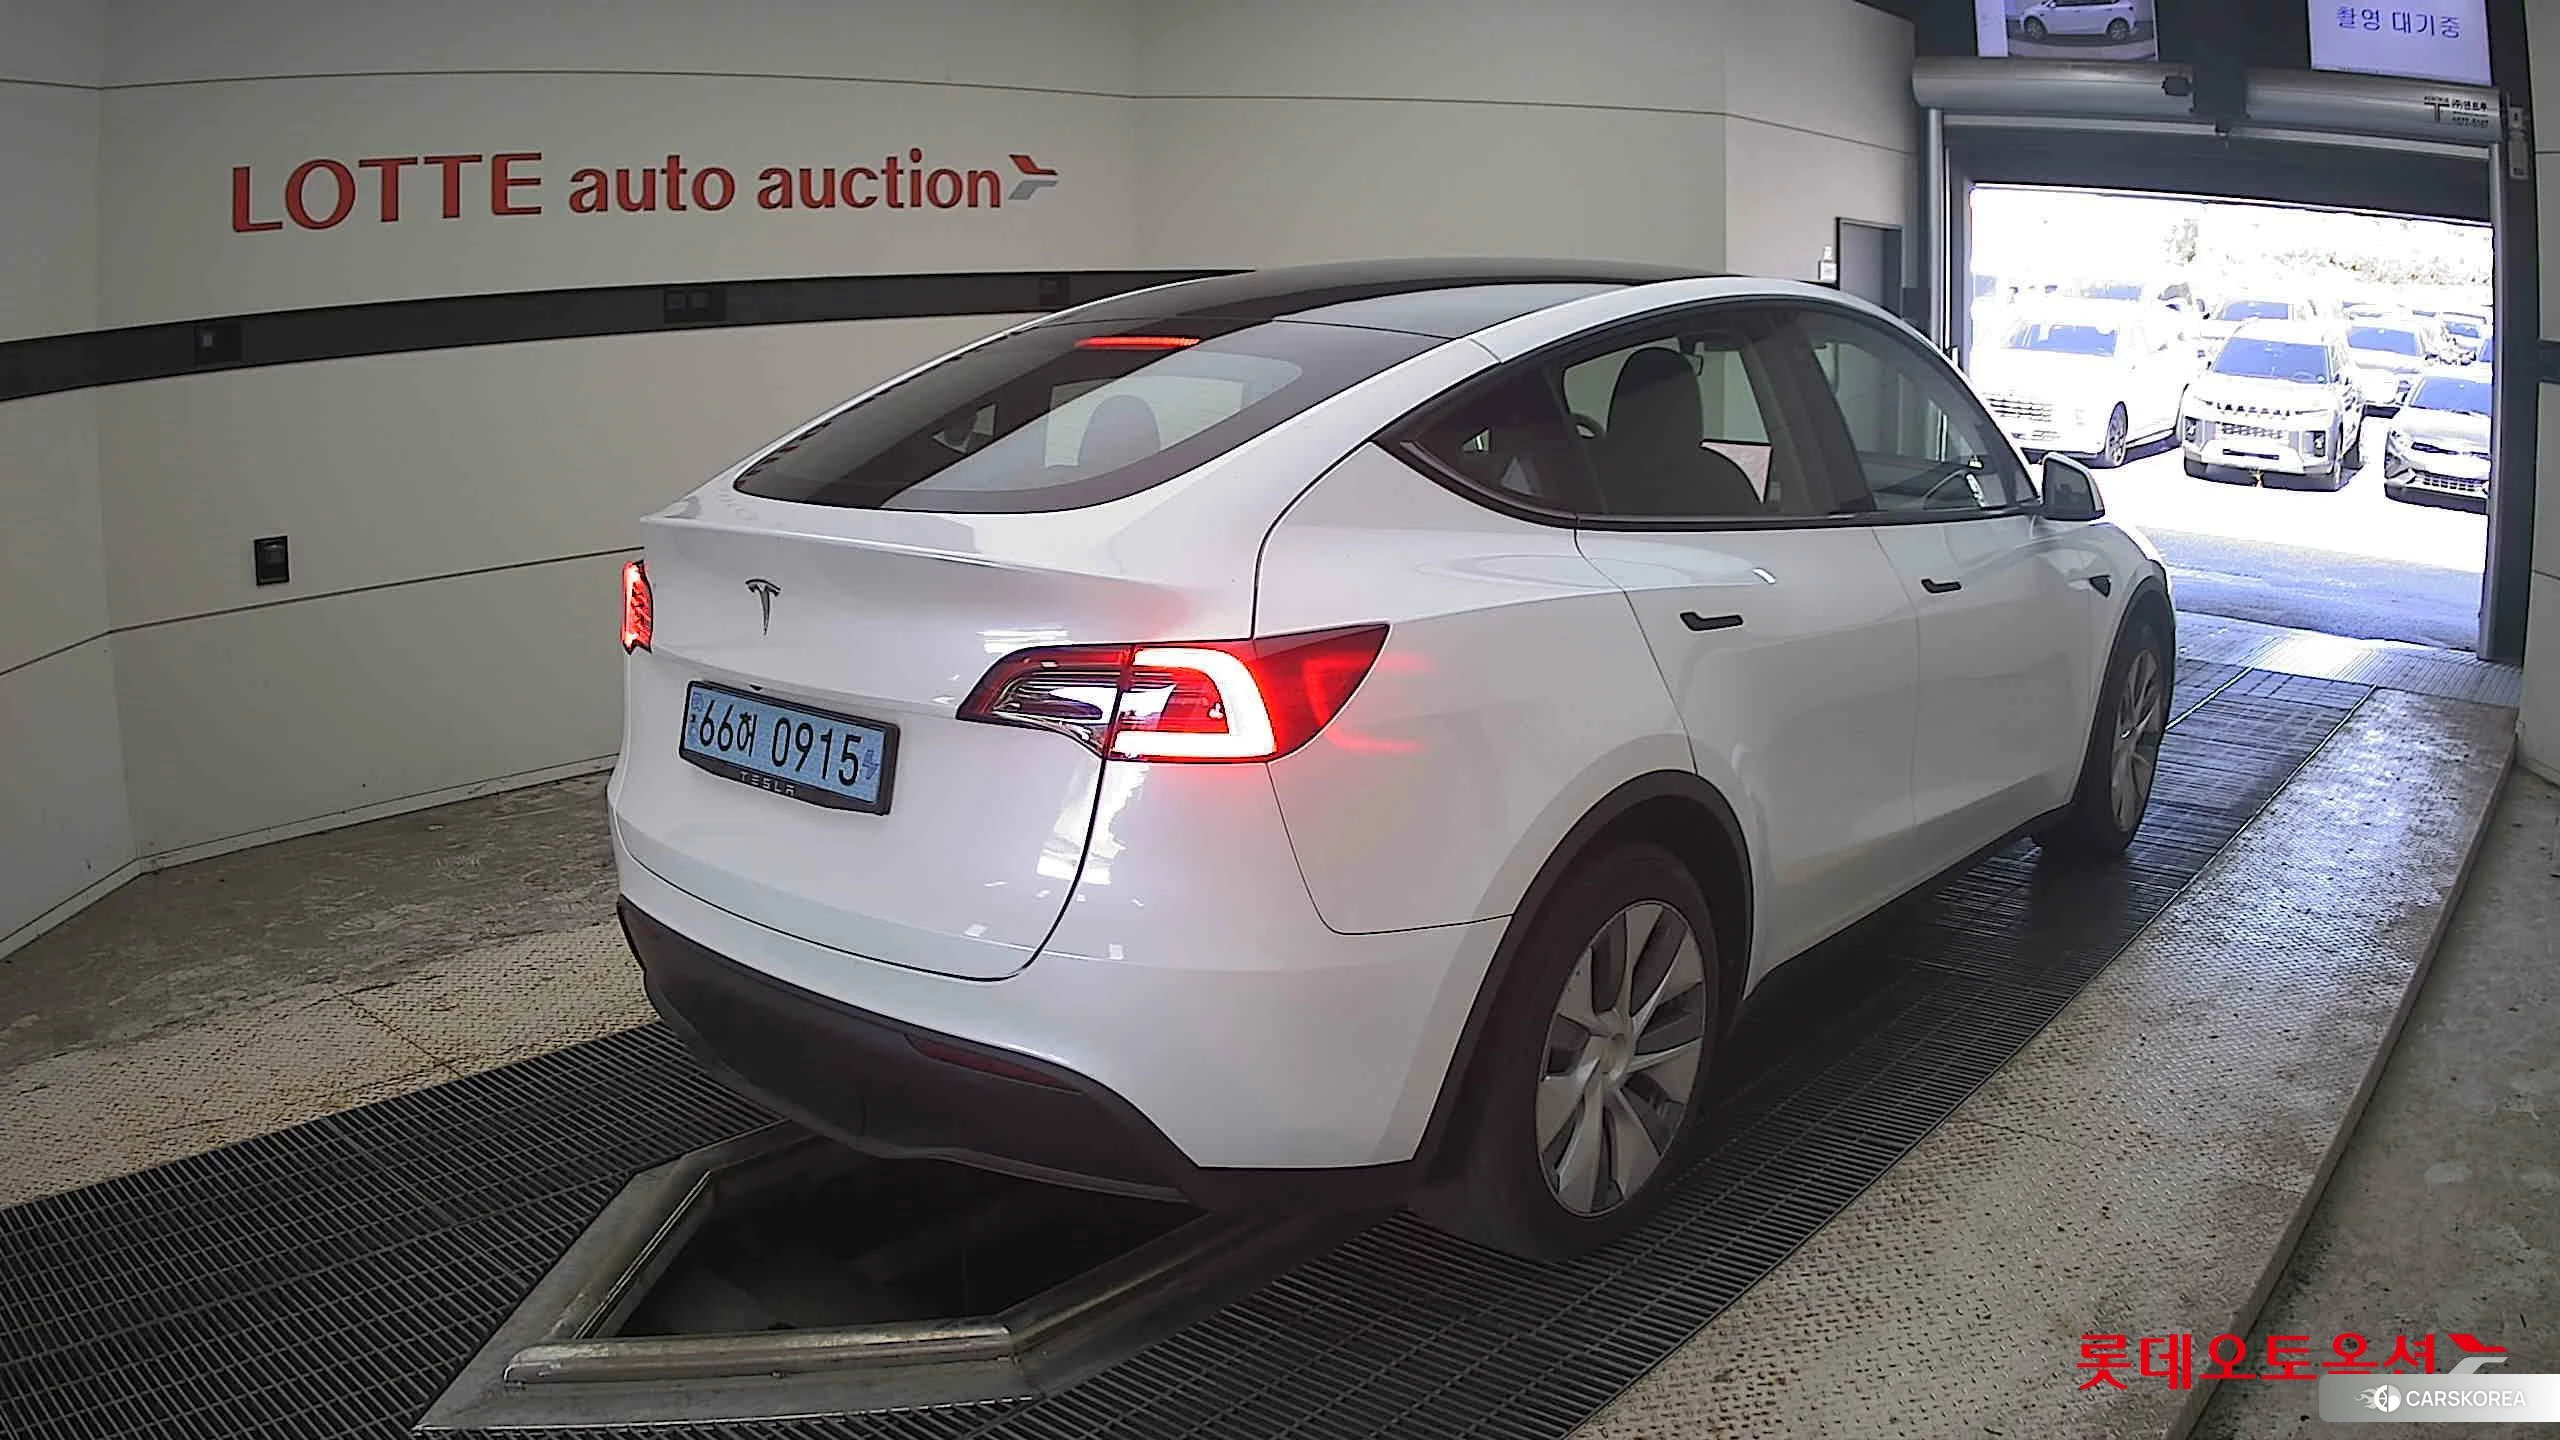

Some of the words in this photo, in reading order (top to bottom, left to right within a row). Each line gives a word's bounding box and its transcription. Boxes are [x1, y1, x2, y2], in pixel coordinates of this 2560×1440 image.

[2338, 7, 2381, 31] 촬영
[2392, 12, 2460, 39] 대기중
[233, 153, 542, 232] LOTTE
[569, 155, 736, 213] auto
[757, 148, 1001, 210] auction
[699, 700, 758, 757] 66허
[771, 717, 862, 786] 0915
[740, 771, 795, 796] TESLA
